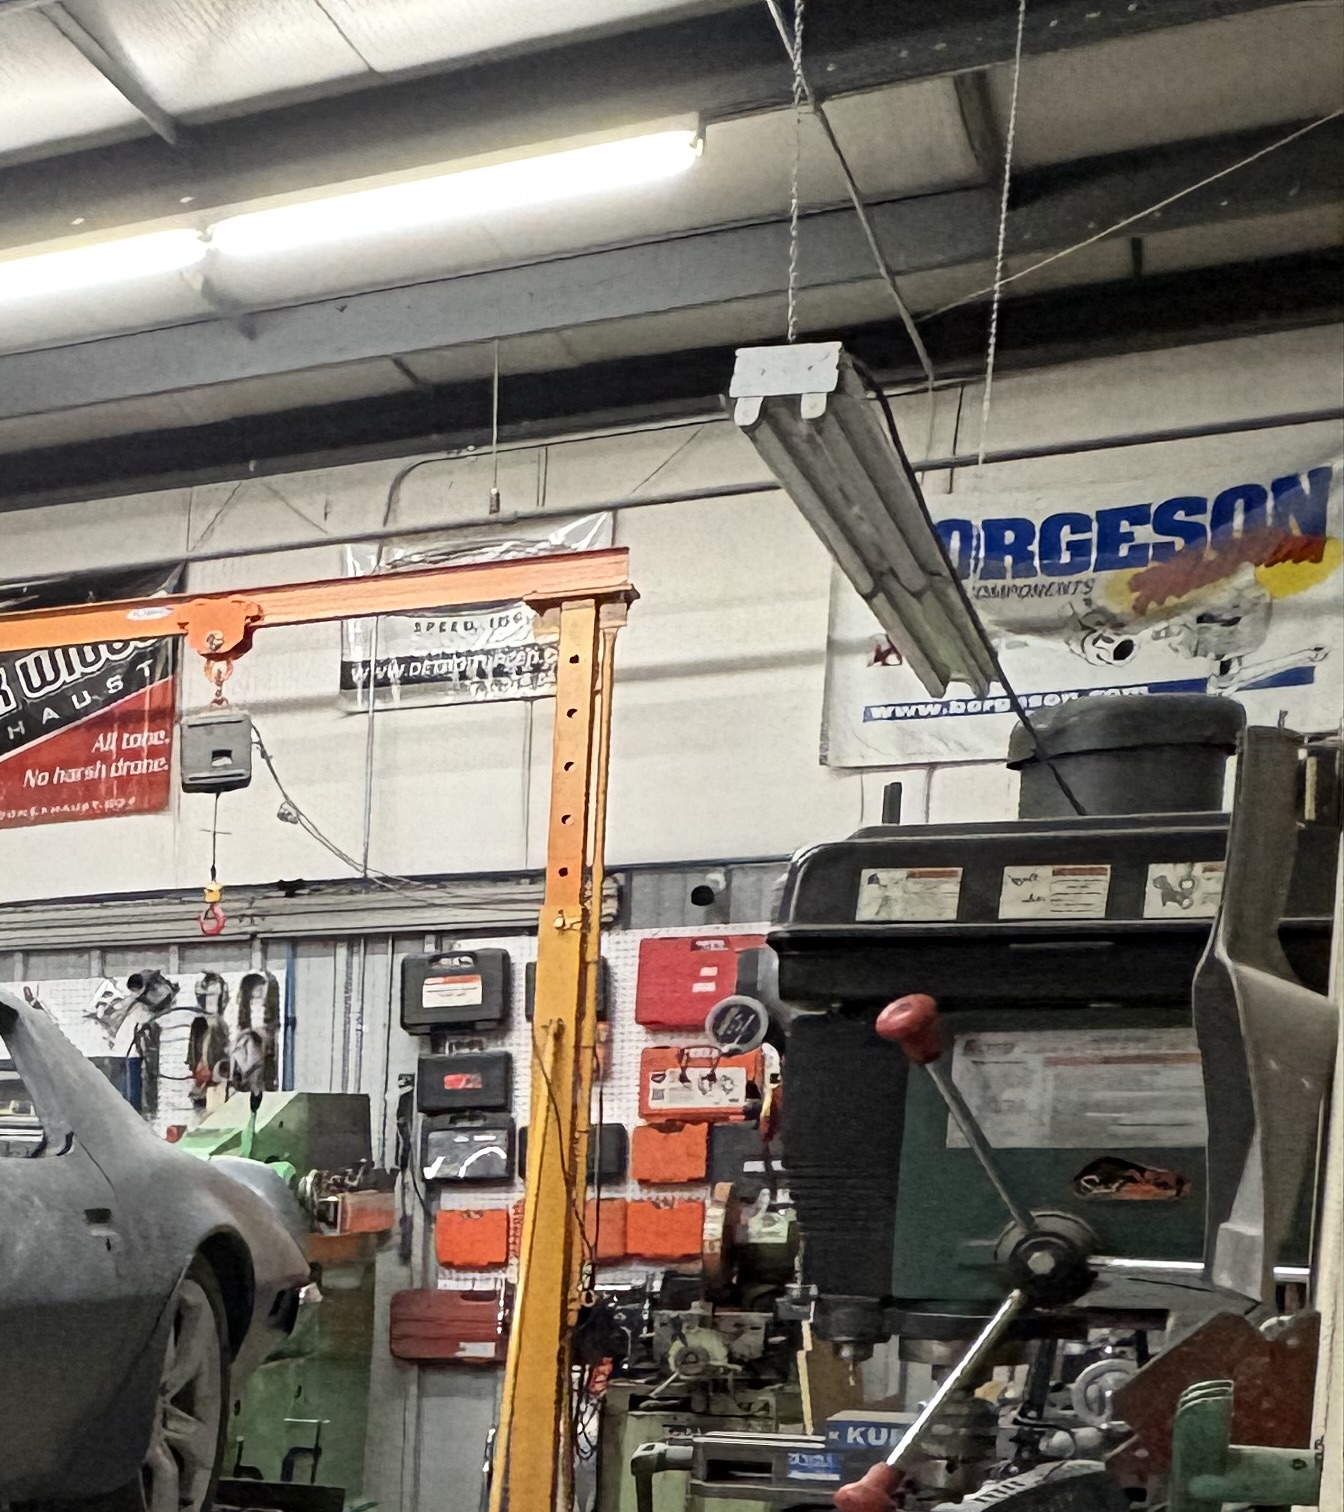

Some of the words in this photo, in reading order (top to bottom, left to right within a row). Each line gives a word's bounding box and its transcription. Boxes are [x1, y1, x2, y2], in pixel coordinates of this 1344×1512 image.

[931, 465, 1333, 580] ORGESON
[91, 731, 118, 753] All
[23, 766, 49, 789] No
[52, 760, 107, 785] harsh
